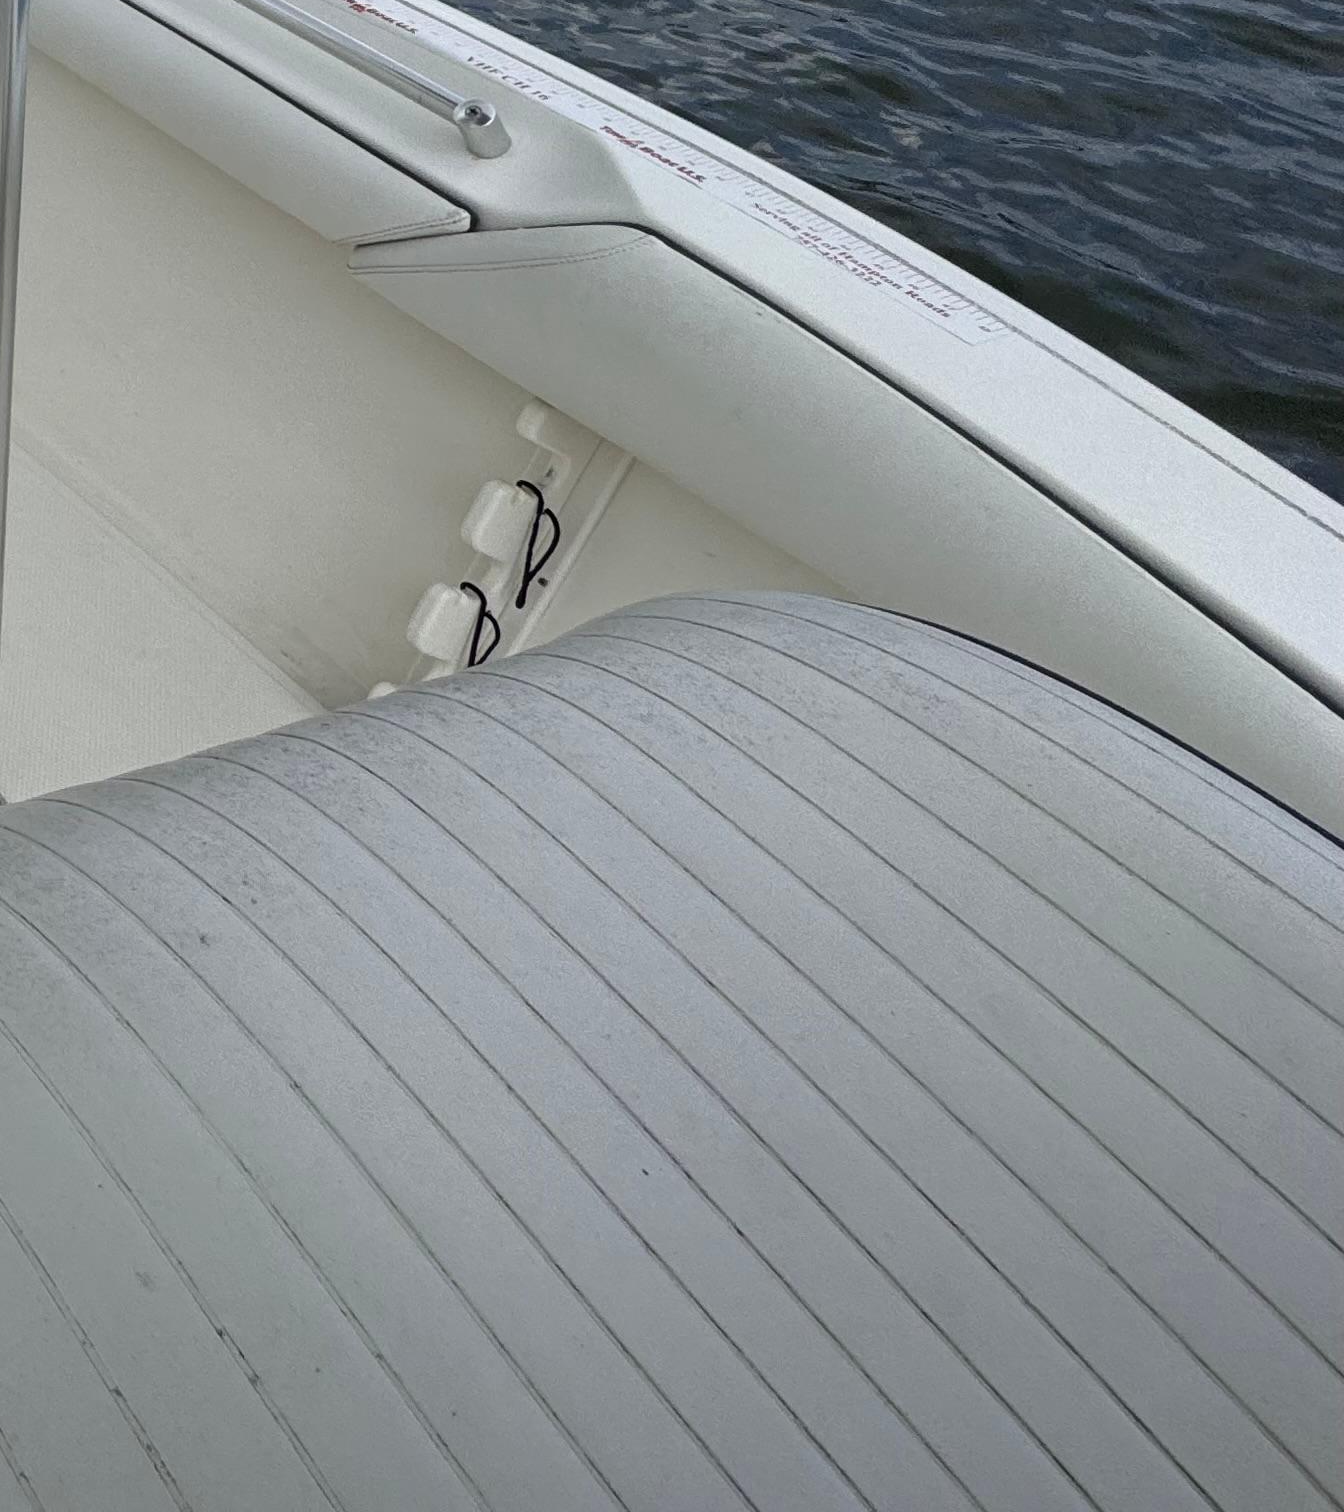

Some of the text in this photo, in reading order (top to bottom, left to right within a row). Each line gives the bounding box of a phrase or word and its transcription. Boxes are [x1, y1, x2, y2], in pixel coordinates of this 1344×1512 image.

[754, 202, 801, 232] Serving
[837, 250, 903, 290] Hampton
[904, 289, 951, 319] Roads
